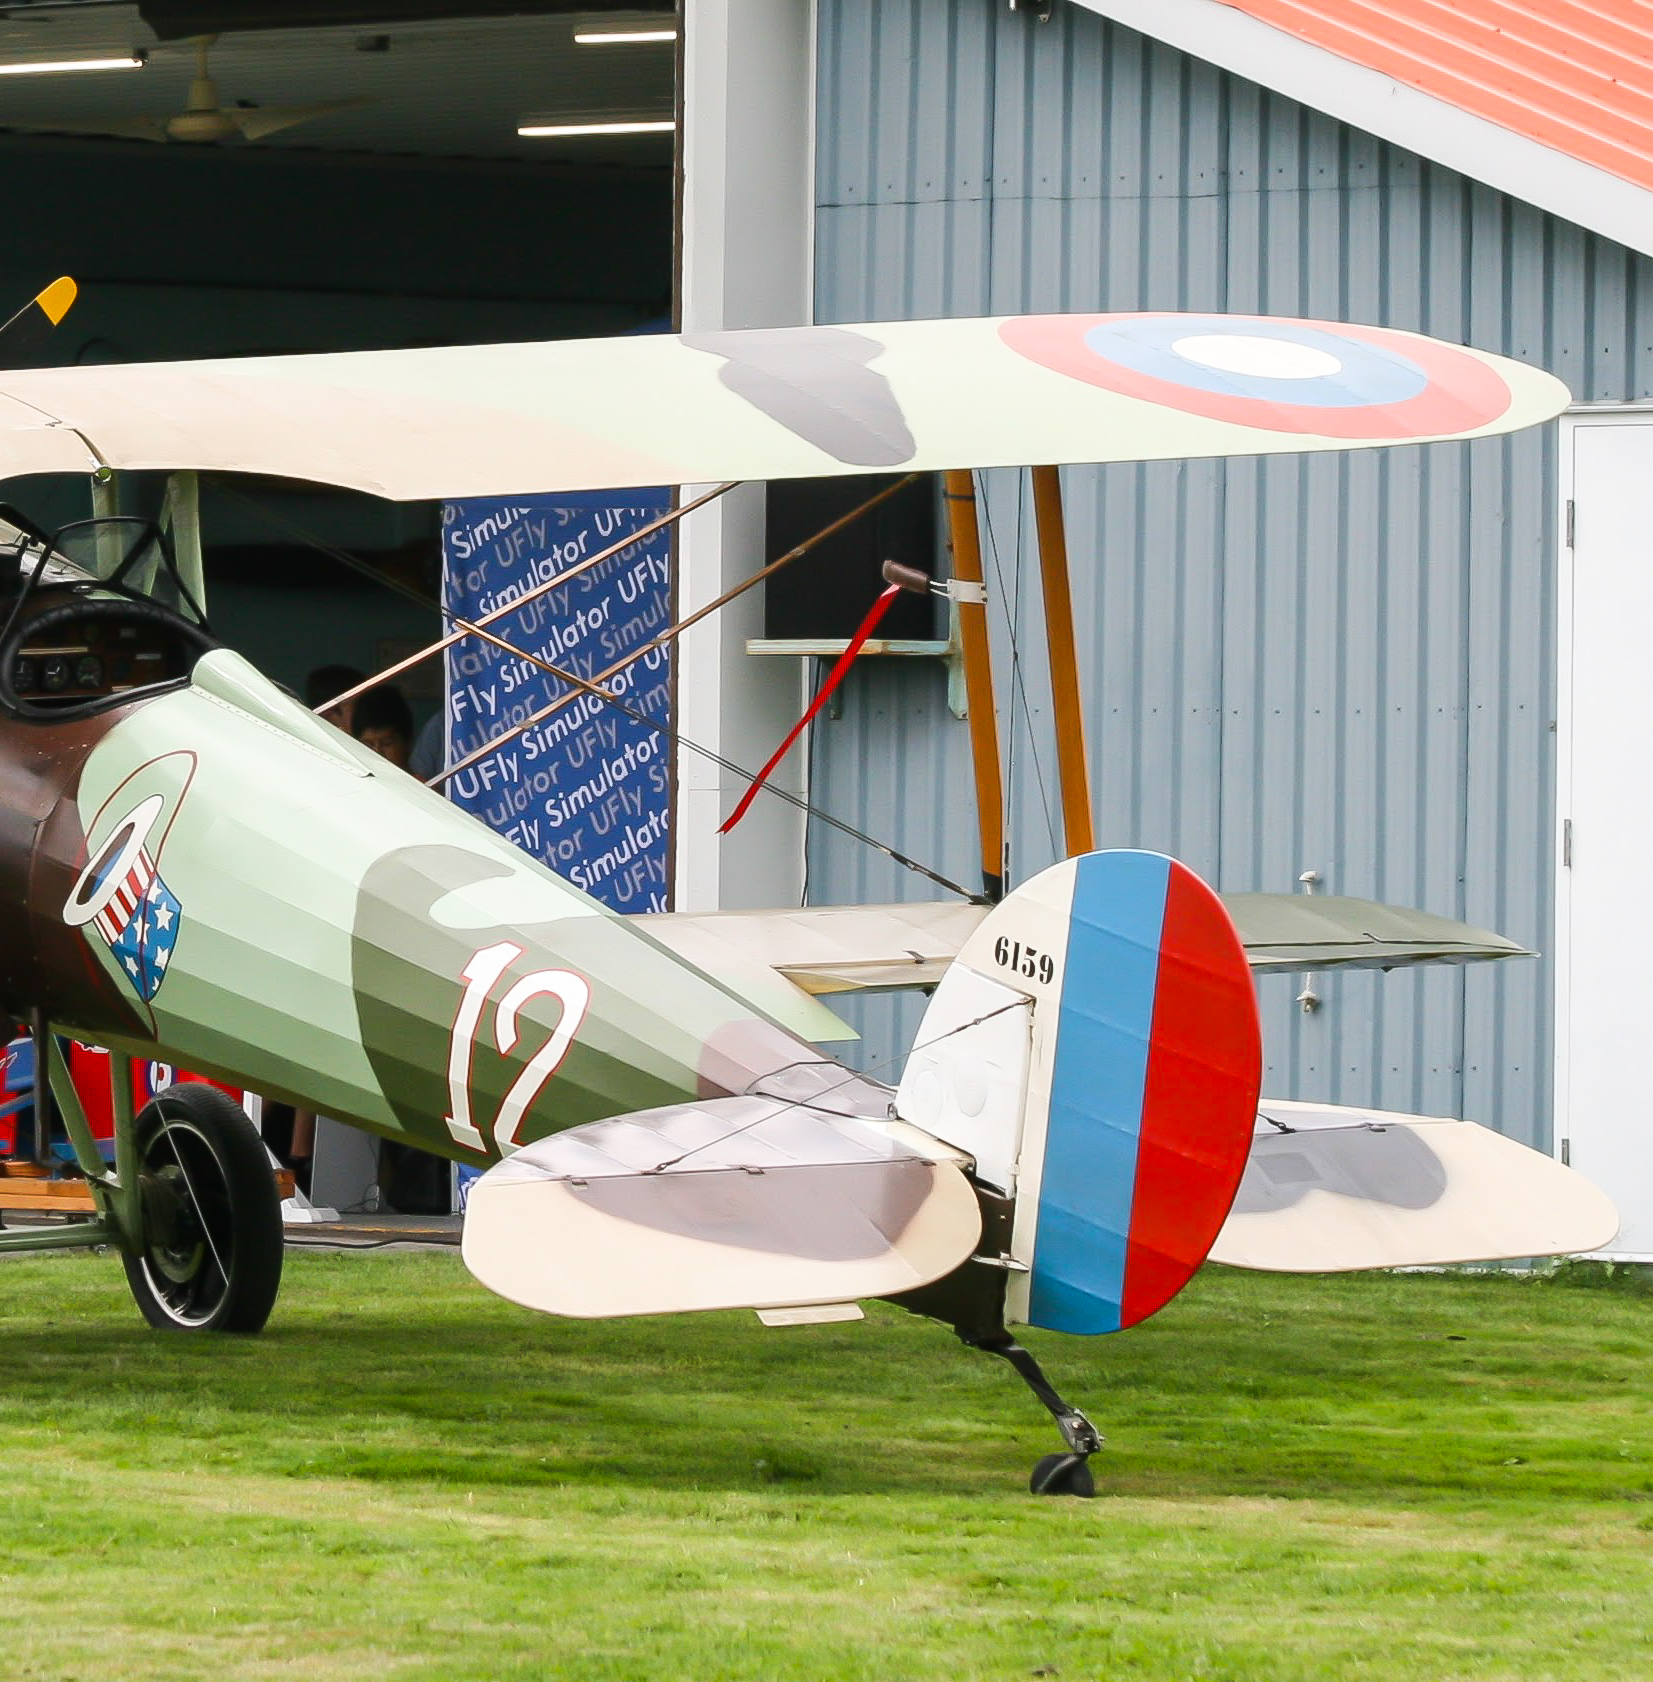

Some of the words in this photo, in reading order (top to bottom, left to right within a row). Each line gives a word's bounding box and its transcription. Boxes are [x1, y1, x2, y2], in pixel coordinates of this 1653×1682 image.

[451, 507, 531, 559] Simu
[494, 518, 547, 569] UFly
[500, 596, 611, 693] Simulator
[617, 553, 669, 604] UFly
[565, 717, 617, 769] UFly
[454, 751, 519, 799] UFly
[545, 729, 661, 828] Simulator
[589, 784, 643, 836] UFly
[614, 851, 667, 904] UFly
[994, 935, 1054, 985] 6159
[443, 940, 591, 1159] 12
